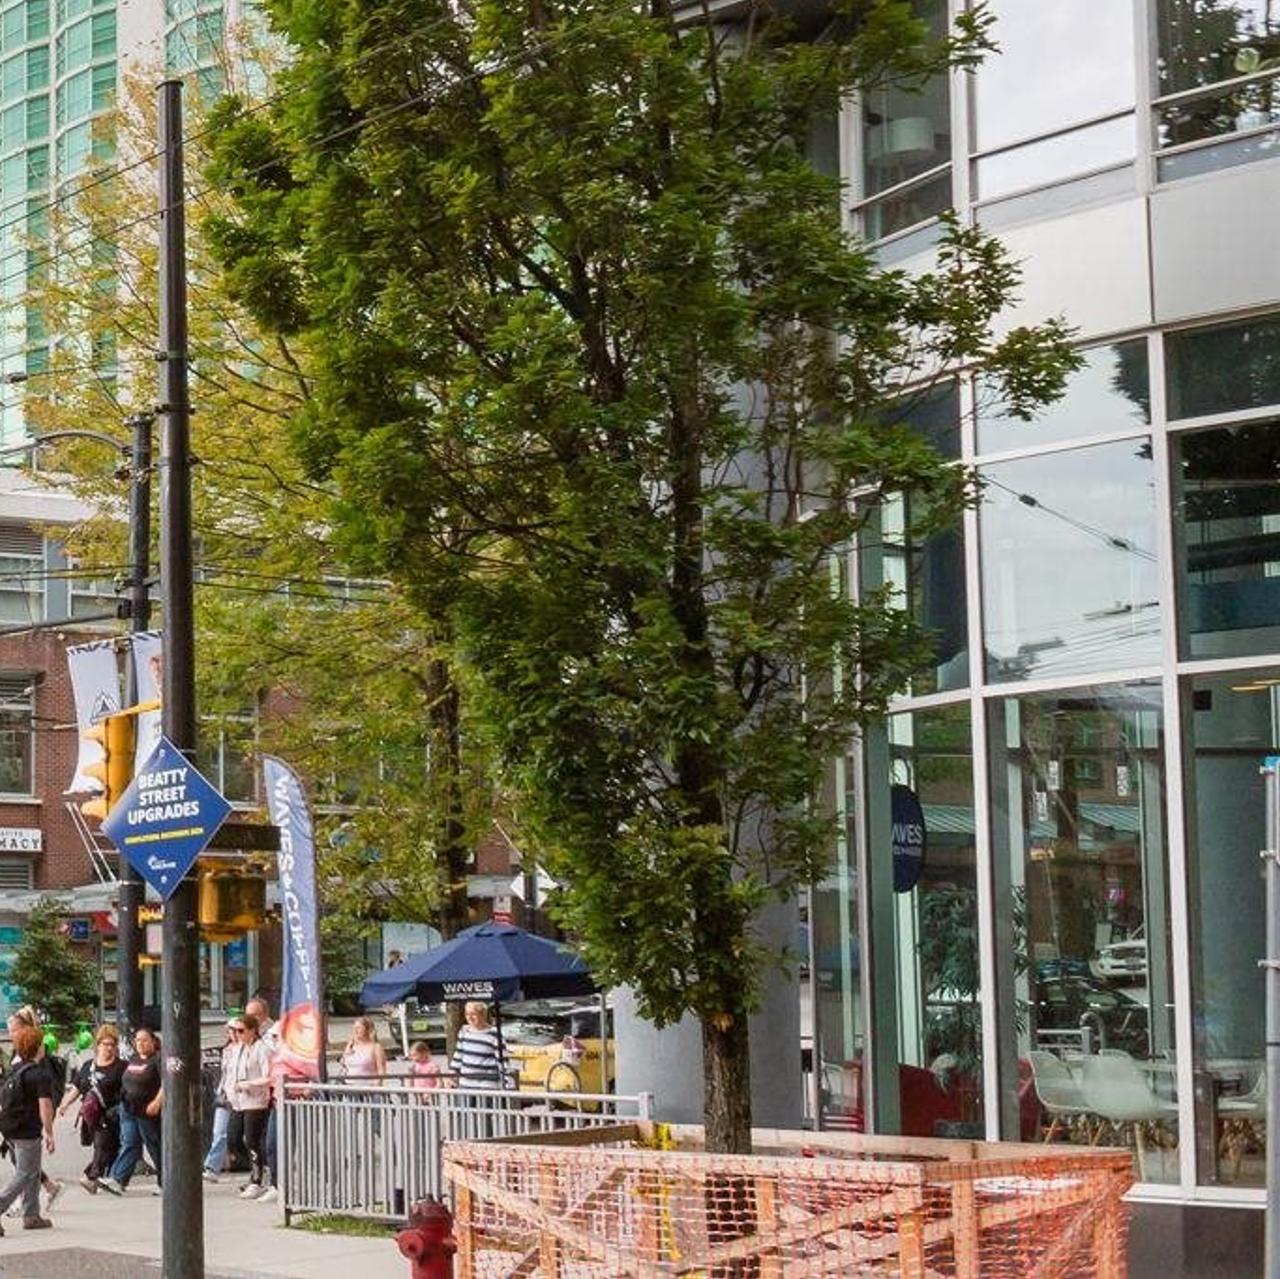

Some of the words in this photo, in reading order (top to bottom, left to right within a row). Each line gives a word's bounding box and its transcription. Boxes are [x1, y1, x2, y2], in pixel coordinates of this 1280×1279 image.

[139, 768, 188, 789] BEATTY
[140, 785, 186, 805] STREET
[128, 801, 200, 825] UPGRADES
[892, 823, 923, 844] AVES
[441, 981, 493, 994] WAVES
